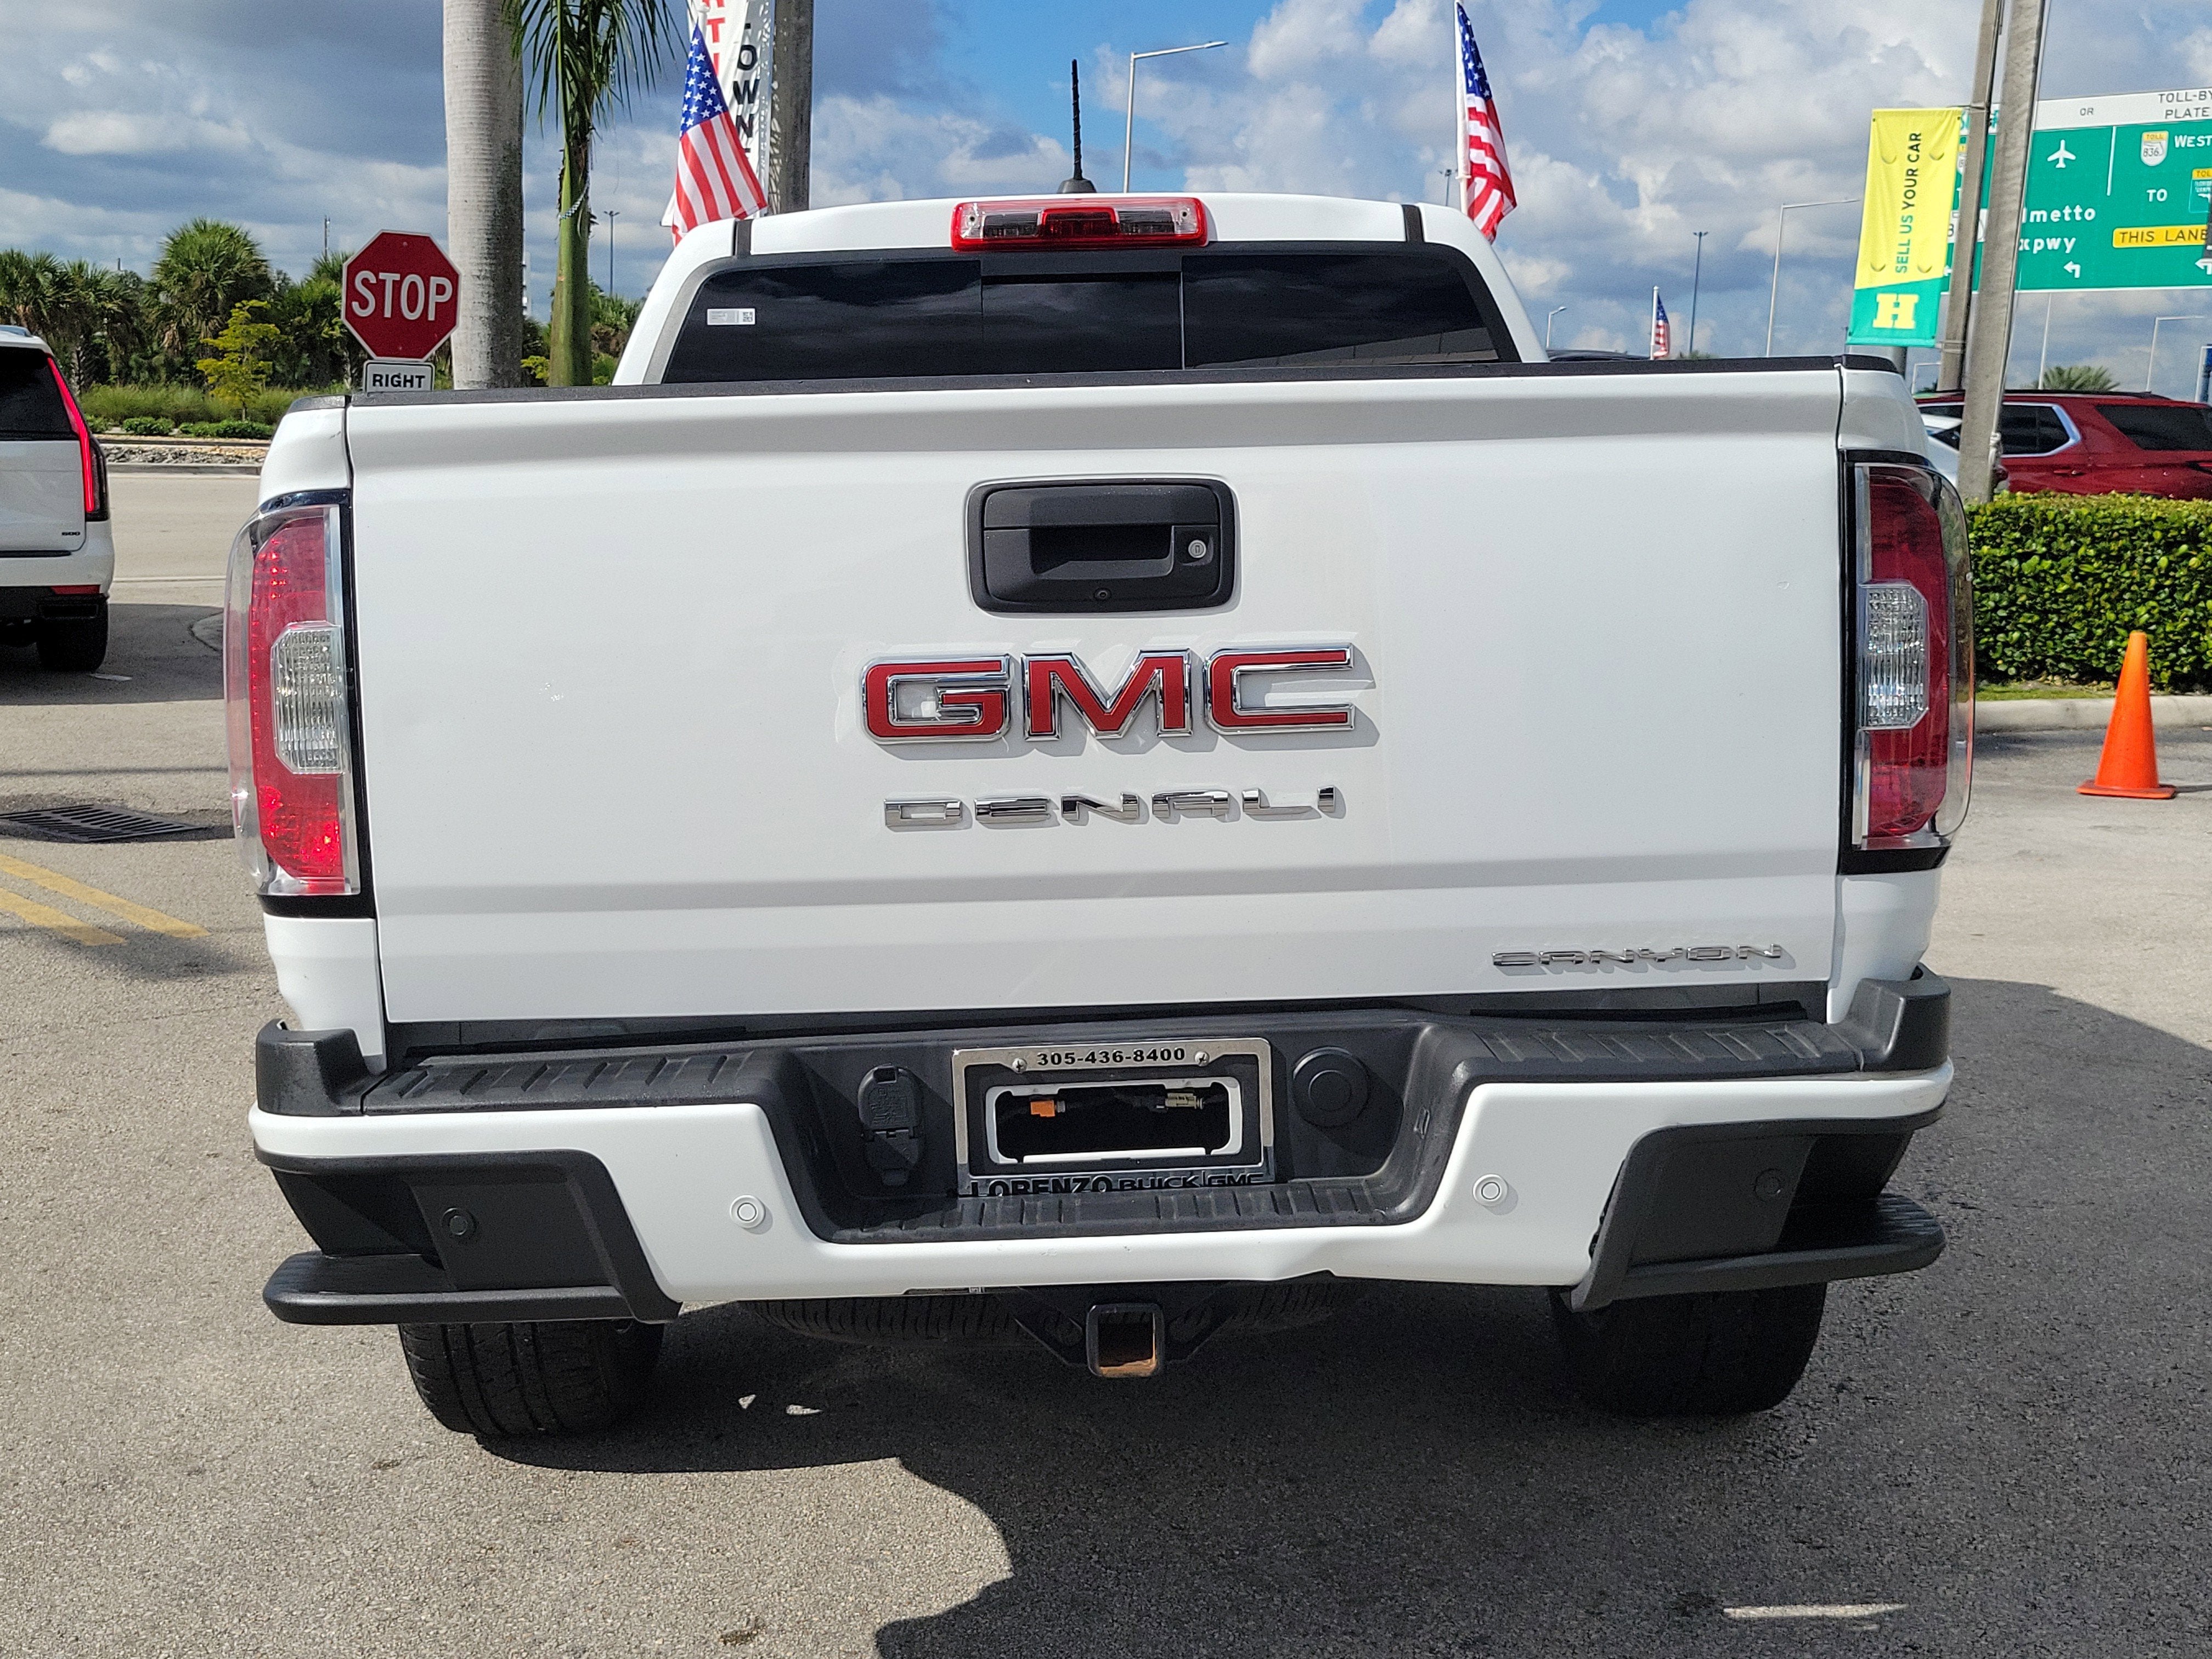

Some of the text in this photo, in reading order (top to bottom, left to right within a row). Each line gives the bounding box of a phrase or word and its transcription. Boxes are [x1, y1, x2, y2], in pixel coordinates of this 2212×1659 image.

[2080, 108, 2094, 116] OR
[2164, 106, 2210, 119] PLATE
[2174, 134, 2212, 148] WEST
[2143, 147, 2159, 157] 836
[2146, 188, 2168, 202] TO
[1895, 132, 1922, 274] SELL US YOUR CAR
[2119, 230, 2155, 243] THIS
[351, 270, 453, 321] STOP
[372, 373, 425, 388] RIGHT
[861, 642, 1354, 743] GMC
[884, 785, 1335, 827] DENALI
[1492, 944, 1781, 966] CANYON
[1037, 1048, 1185, 1065] 305-436-8400
